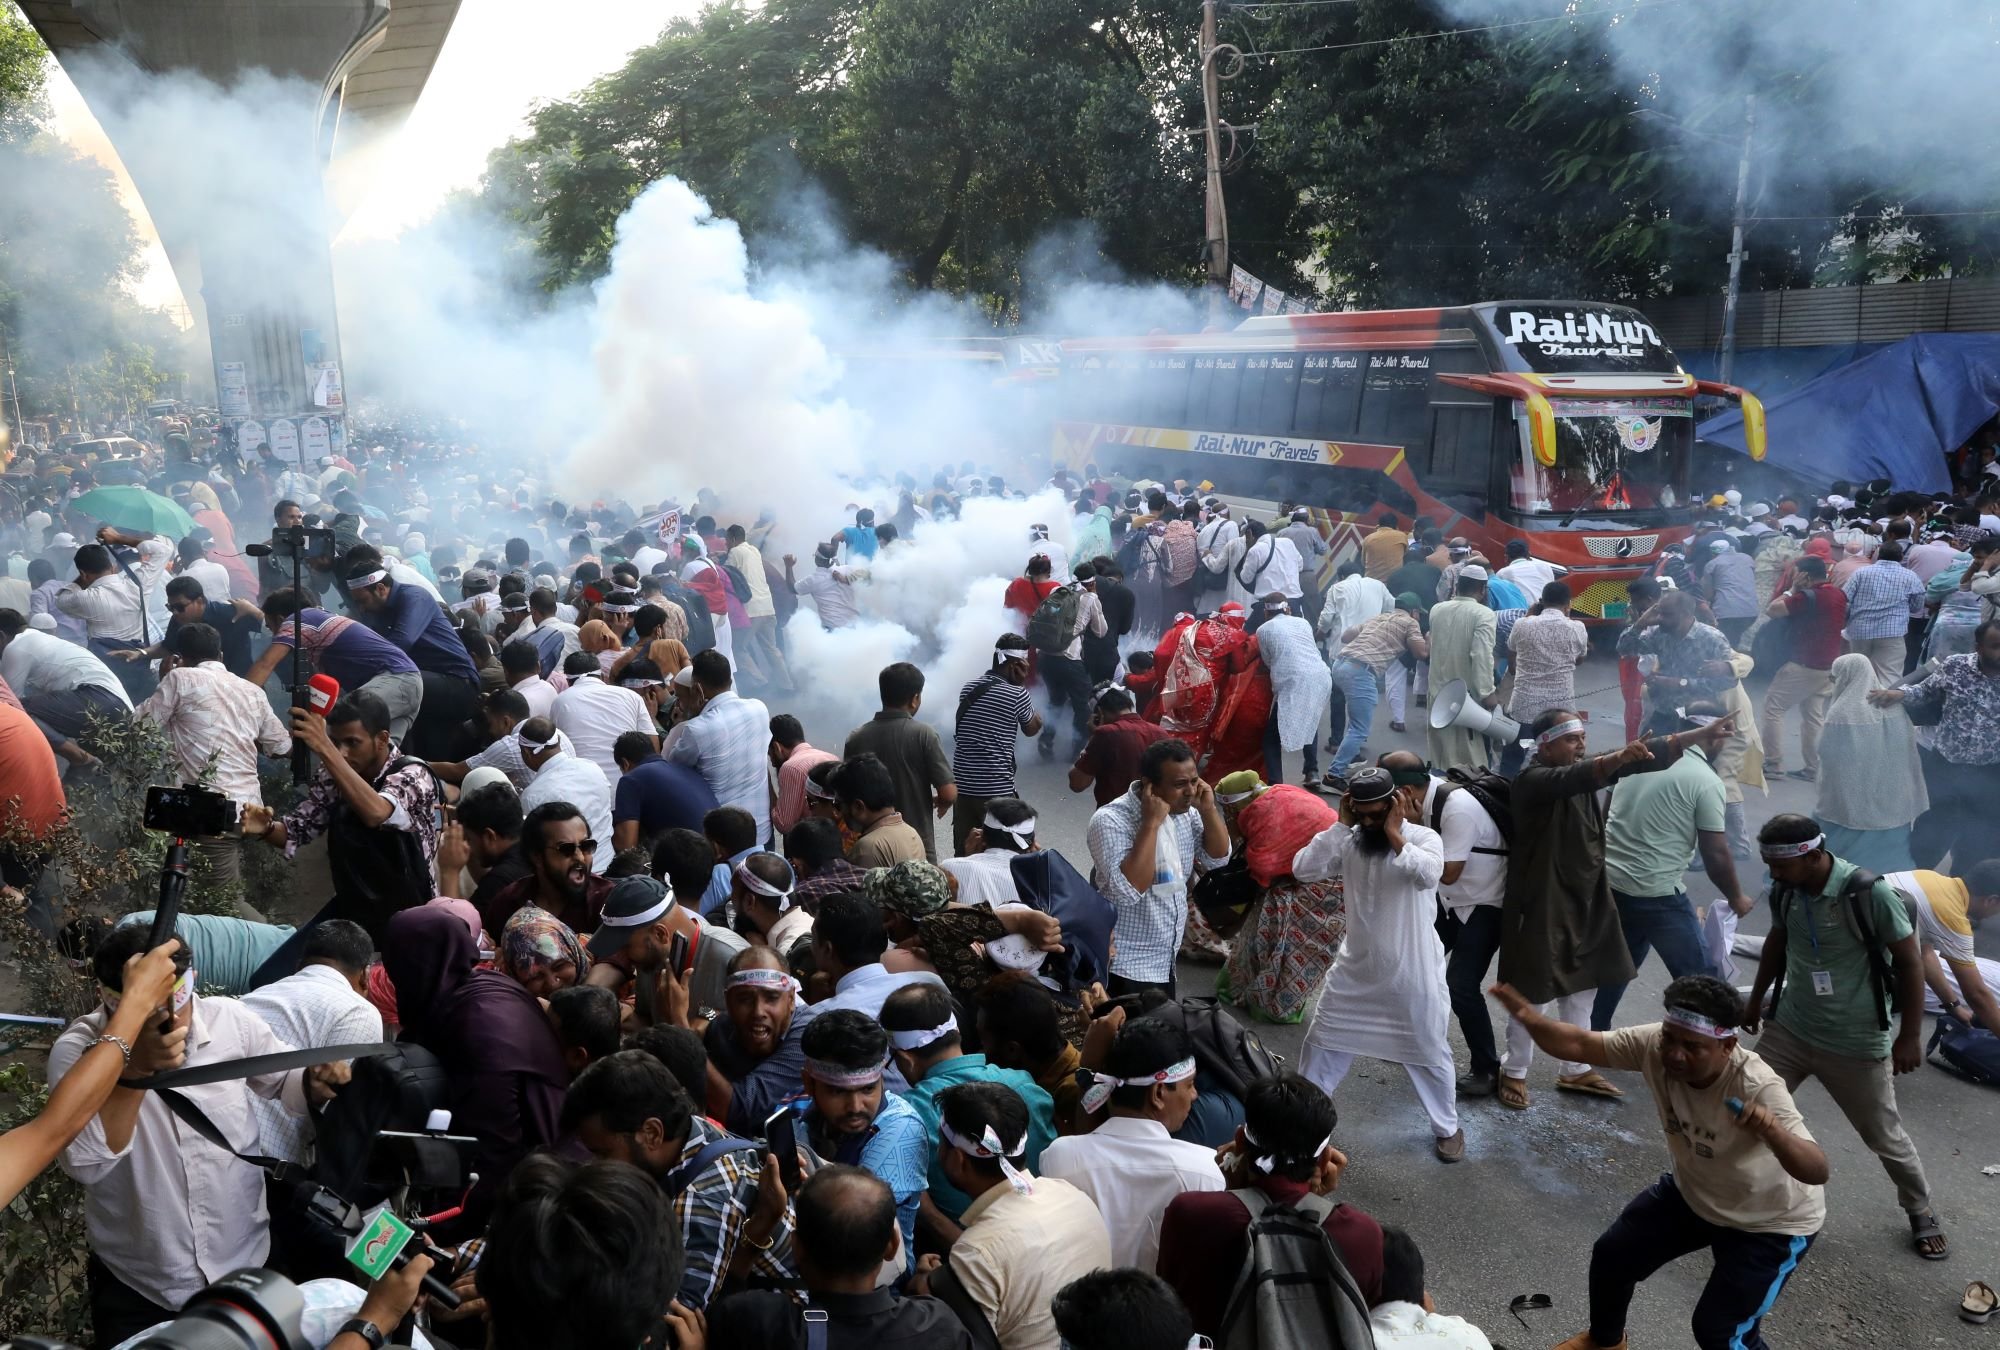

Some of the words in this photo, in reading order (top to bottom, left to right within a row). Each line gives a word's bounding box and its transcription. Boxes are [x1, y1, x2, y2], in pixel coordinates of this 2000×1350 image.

[1505, 311, 1662, 347] Rai-Nur
[1539, 343, 1644, 357] Travels
[1271, 358, 1294, 369] Travels
[1304, 357, 1328, 368] Rai-Nur
[1331, 356, 1358, 368] Travels
[1370, 356, 1398, 368] Rai-Nur
[1400, 355, 1430, 368] Travels
[1269, 440, 1320, 462] Travels
